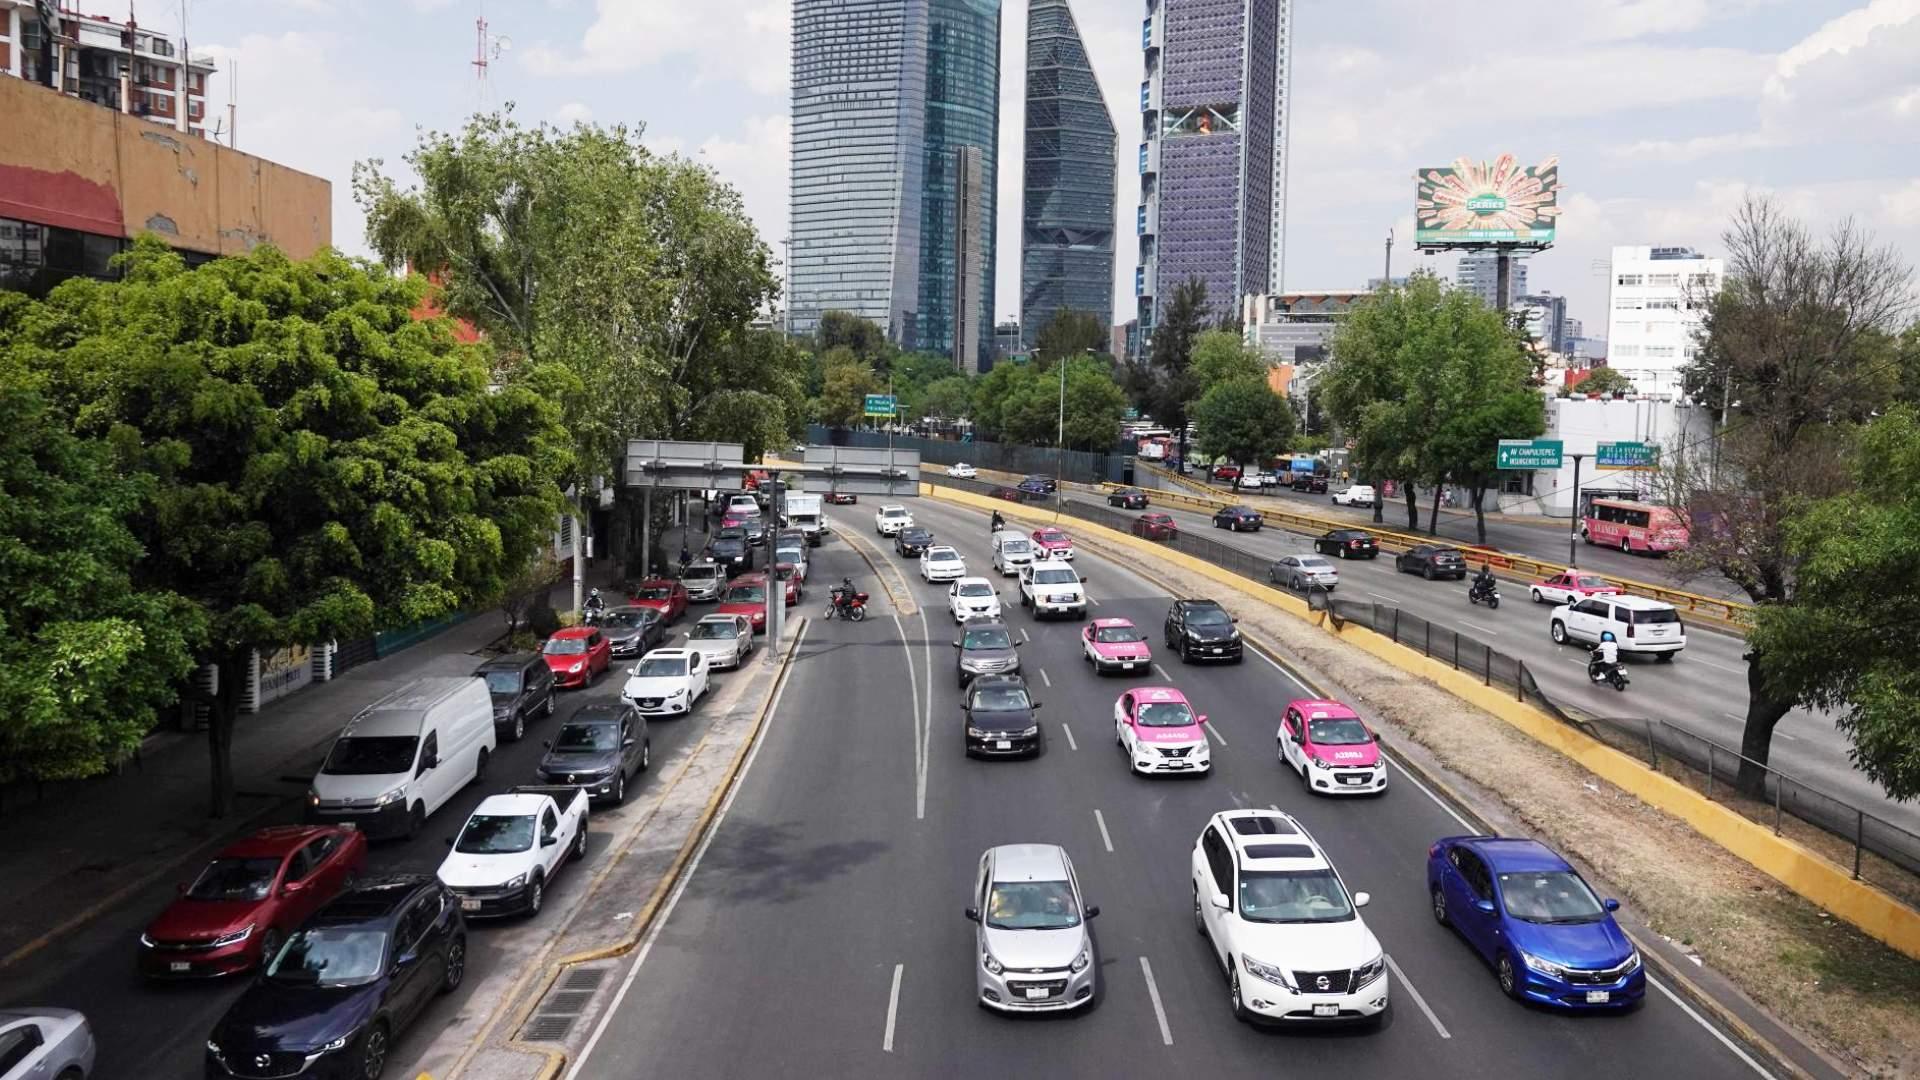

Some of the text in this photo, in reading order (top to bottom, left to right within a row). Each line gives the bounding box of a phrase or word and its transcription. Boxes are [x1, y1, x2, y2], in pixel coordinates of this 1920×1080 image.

[1468, 200, 1504, 209] SERIES
[1510, 448, 1556, 456] AV CHAPULTEPEC
[1510, 457, 1559, 466] INSURGENTES CENTRO
